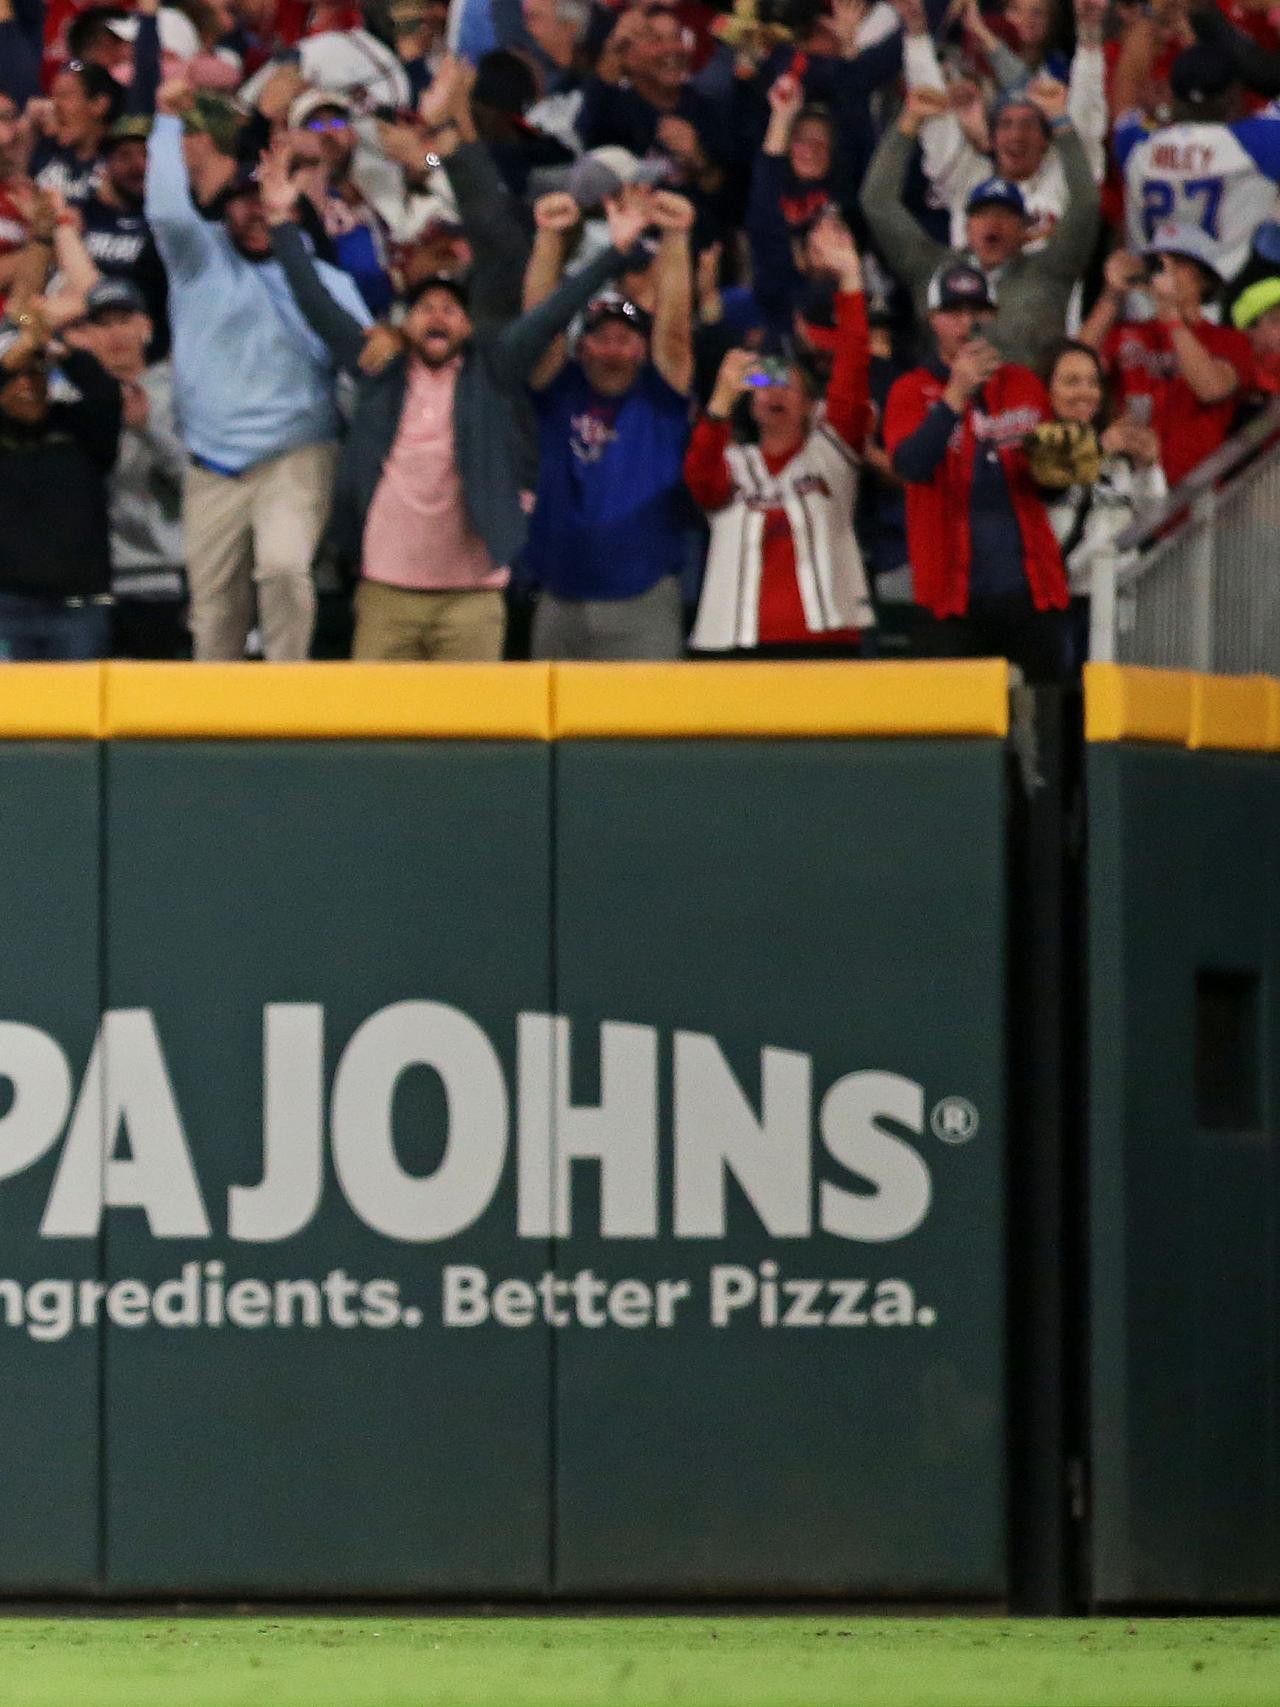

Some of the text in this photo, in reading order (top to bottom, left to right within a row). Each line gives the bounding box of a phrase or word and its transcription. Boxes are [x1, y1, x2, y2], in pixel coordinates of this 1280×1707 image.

[1142, 176, 1224, 242] 27
[227, 999, 933, 1242] JOHNS
[441, 1264, 691, 1328] Better
[709, 1260, 937, 1328] Pizza.
